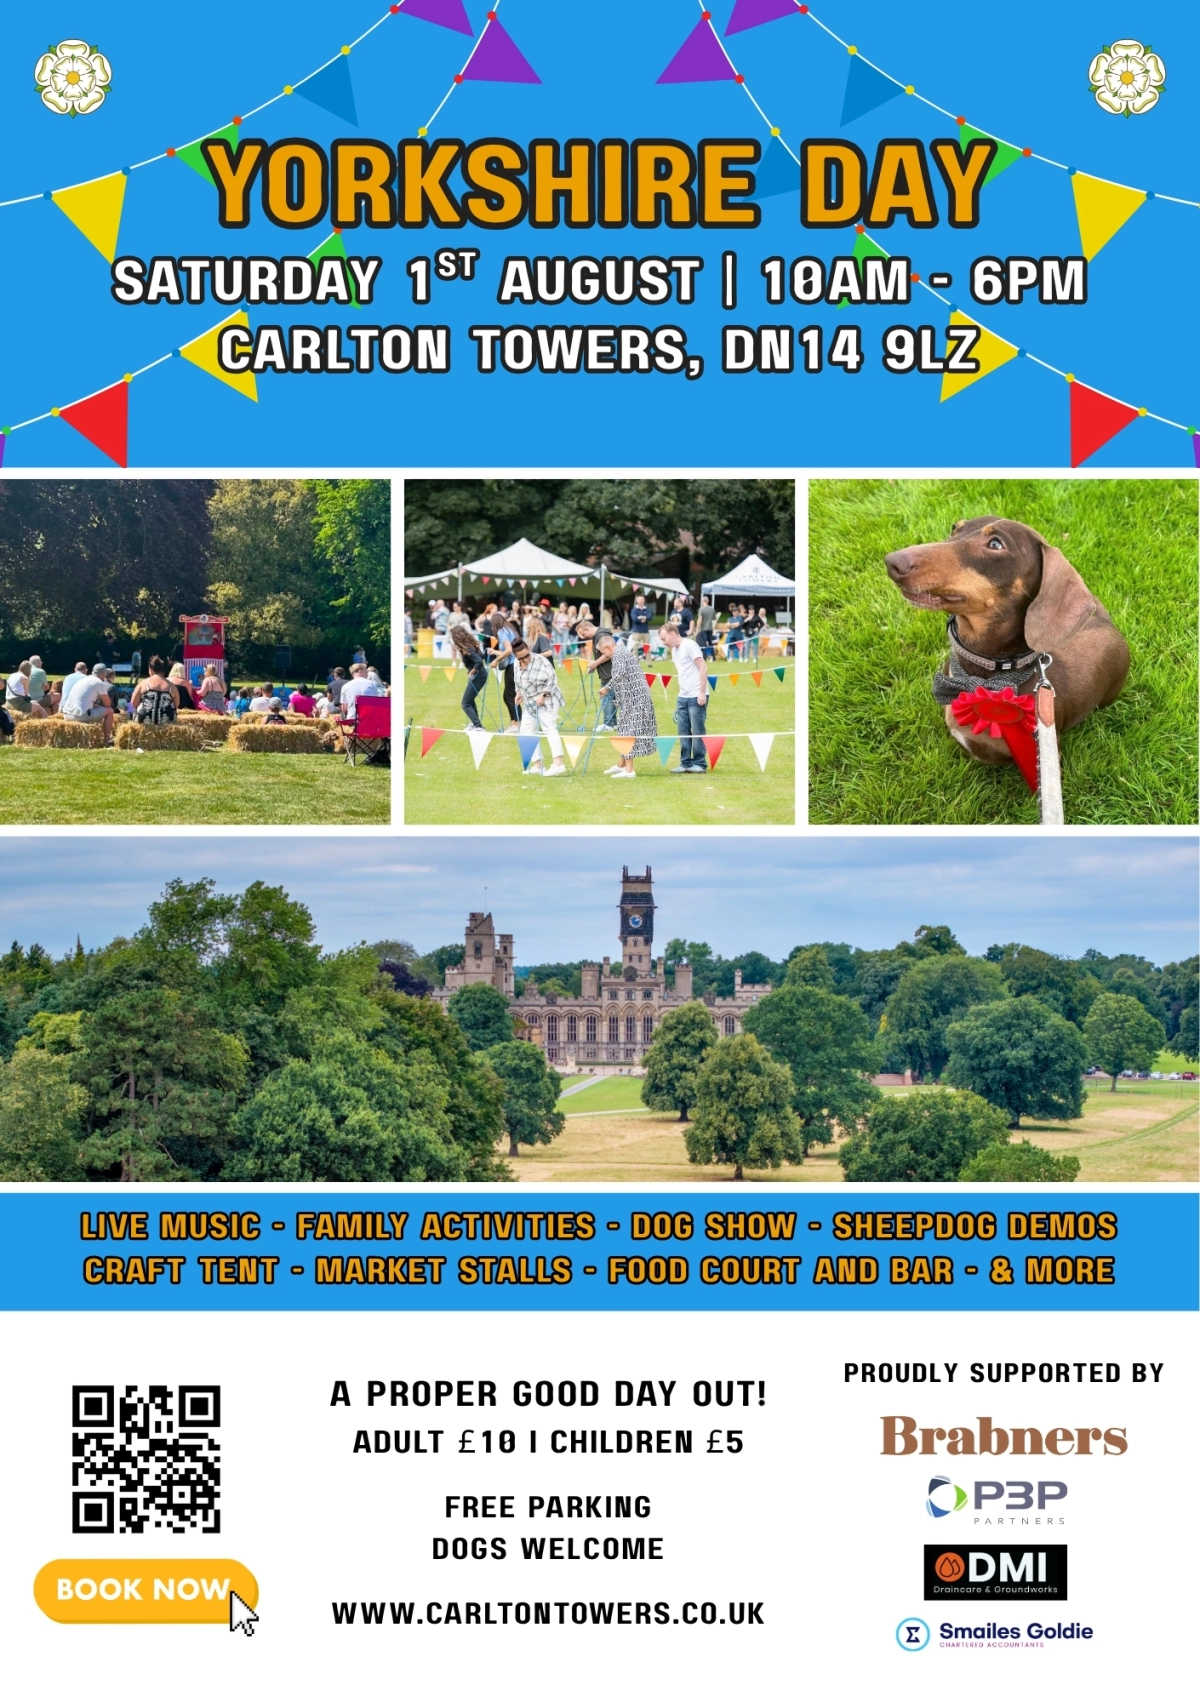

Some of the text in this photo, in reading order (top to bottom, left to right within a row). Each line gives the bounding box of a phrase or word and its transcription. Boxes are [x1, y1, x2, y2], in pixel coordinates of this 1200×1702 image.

[205, 142, 993, 225] YORKSHIRE DAY
[114, 259, 380, 302] SATURDAY
[409, 251, 478, 302] 1ST
[500, 259, 701, 302] AUGUST
[764, 259, 909, 302] 10AM
[973, 259, 1086, 302] 6PM
[221, 328, 979, 377] CARLTON TOWERS, DN14 9LZ
[82, 1213, 148, 1239] LIVE
[162, 1213, 259, 1239] MUSIC
[298, 1213, 407, 1239] FAMILY
[422, 1213, 595, 1239] ACTIVITIES
[633, 1213, 692, 1239] DOG
[707, 1213, 795, 1239] SHOW
[835, 1213, 995, 1239] SHEEPDOG
[1010, 1213, 1116, 1239] DEMOS
[85, 1257, 184, 1283] CRAFT
[199, 1257, 279, 1283] TENT
[317, 1257, 446, 1283] MARKET
[460, 1257, 571, 1283] STALLS
[610, 1257, 687, 1283] FOOD
[702, 1257, 800, 1283] COURT
[815, 1257, 877, 1283] AND
[892, 1257, 952, 1283] BAR
[991, 1257, 1013, 1284] &
[1027, 1257, 1113, 1284] MORE
[844, 1362, 1164, 1384] PROUDLY SUPPORTED BY
[330, 1380, 766, 1407] A PROPER GOOD DAY OUT!
[353, 1429, 445, 1454] ADULT
[458, 1429, 516, 1454] £10
[550, 1429, 693, 1454] CHILDREN
[706, 1429, 744, 1454] £5
[880, 1415, 1129, 1456] Brabners
[445, 1495, 651, 1518] FREE PARKING
[974, 1517, 1065, 1525] PARTNERS
[432, 1537, 664, 1560] DOGS WELCOME
[968, 1552, 1047, 1583] DMI
[57, 1577, 231, 1601] BOOK NOW
[933, 1585, 1058, 1594] Draincare & Groundworks
[331, 1601, 765, 1625] WWW.CARLTONTOWERS.CO.UK
[939, 1622, 1094, 1640] Smailes Goldie
